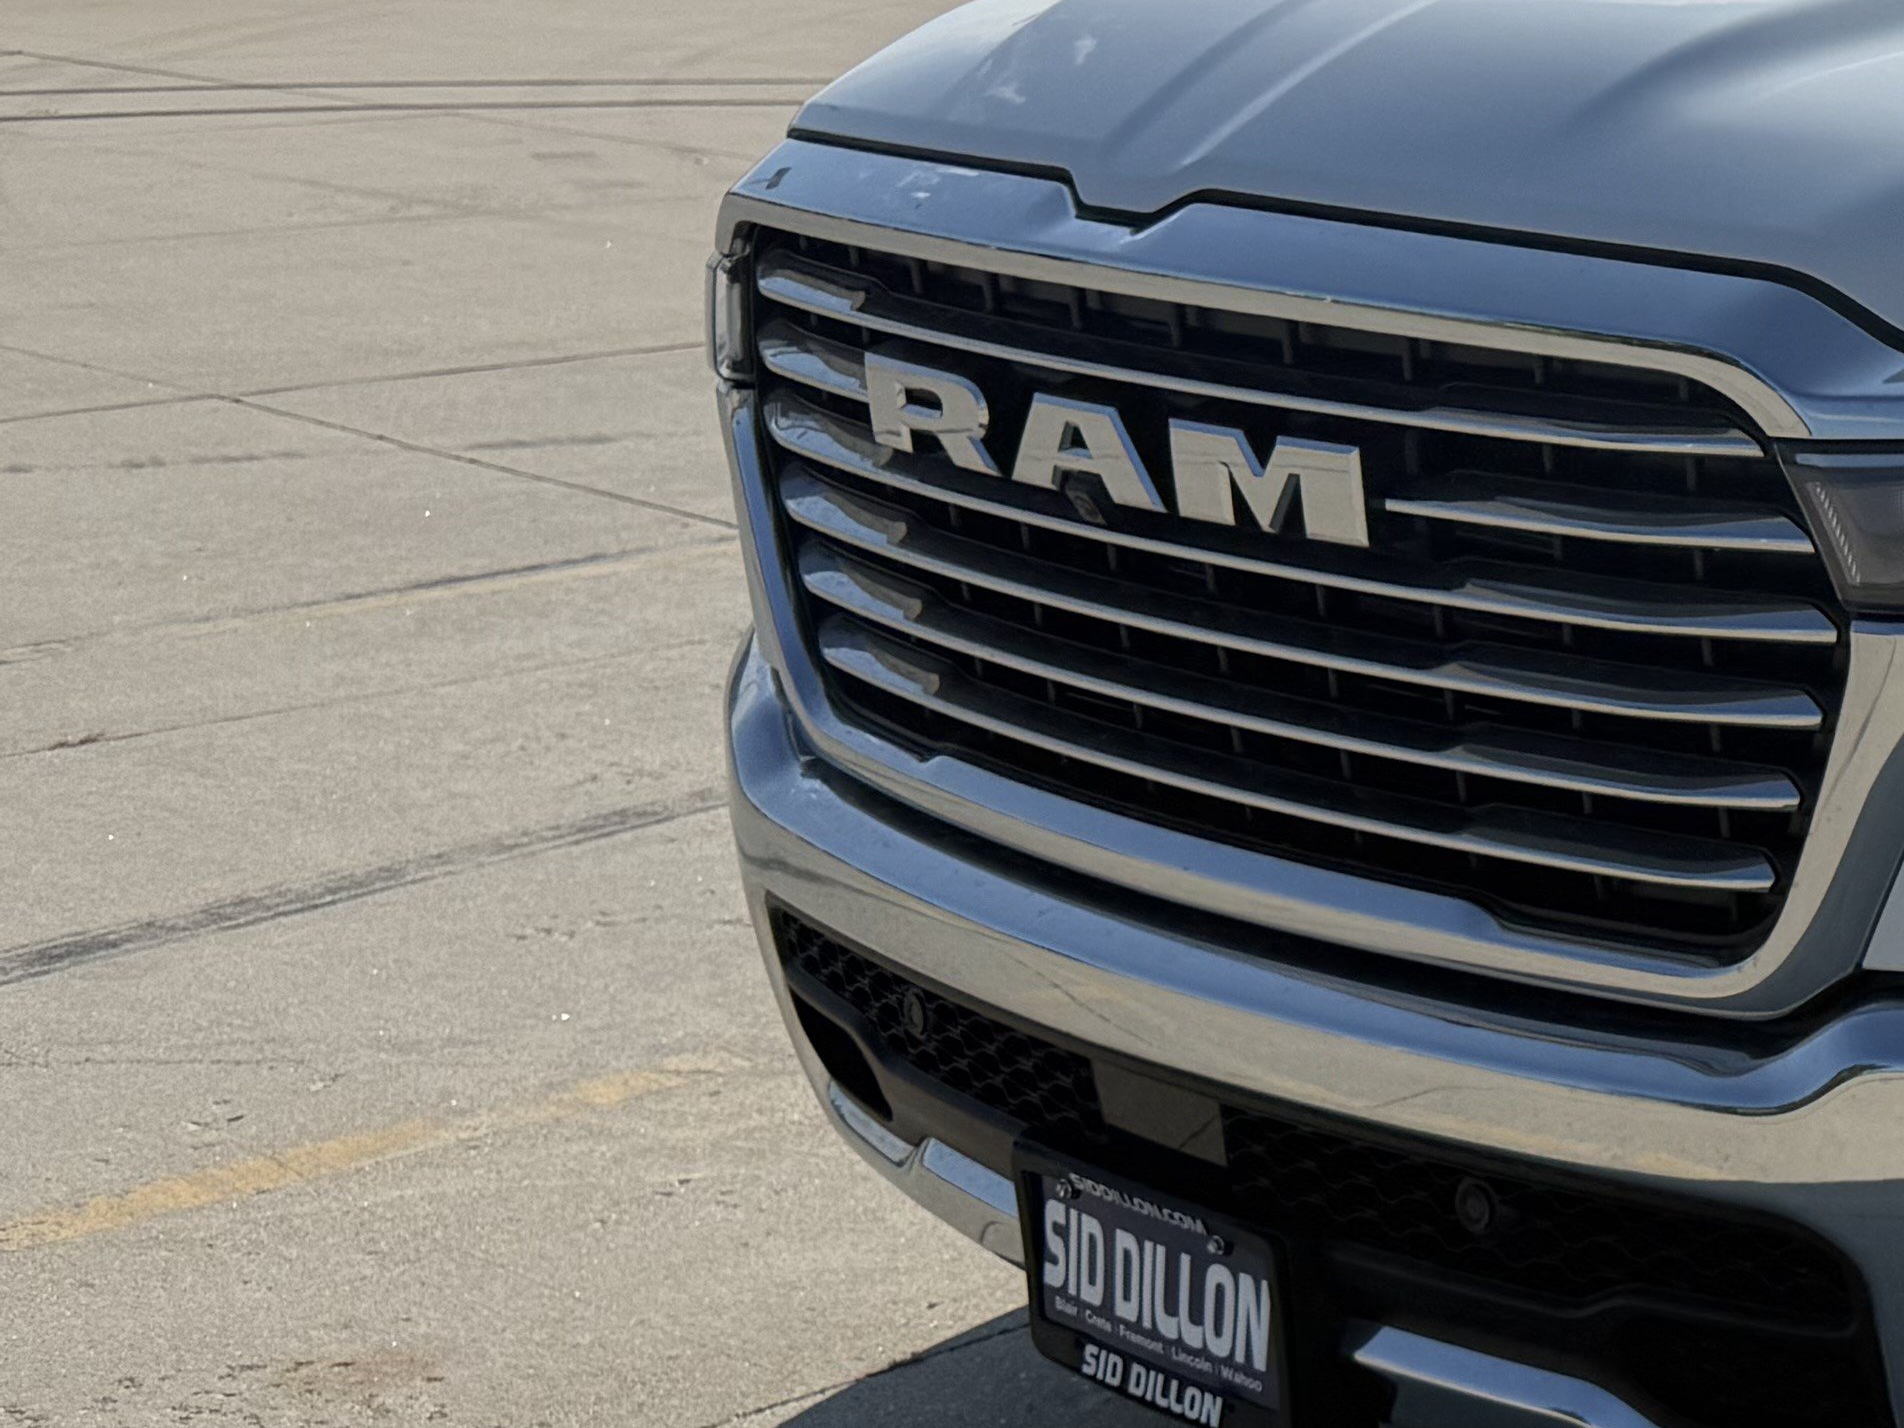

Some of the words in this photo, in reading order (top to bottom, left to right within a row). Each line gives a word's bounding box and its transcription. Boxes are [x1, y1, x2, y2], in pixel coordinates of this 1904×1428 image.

[864, 351, 1371, 548] RAM
[1043, 1198, 1105, 1308] SID
[1114, 1227, 1271, 1372] DILLON
[1081, 1343, 1124, 1388] SID
[1127, 1361, 1223, 1428] DILLON
